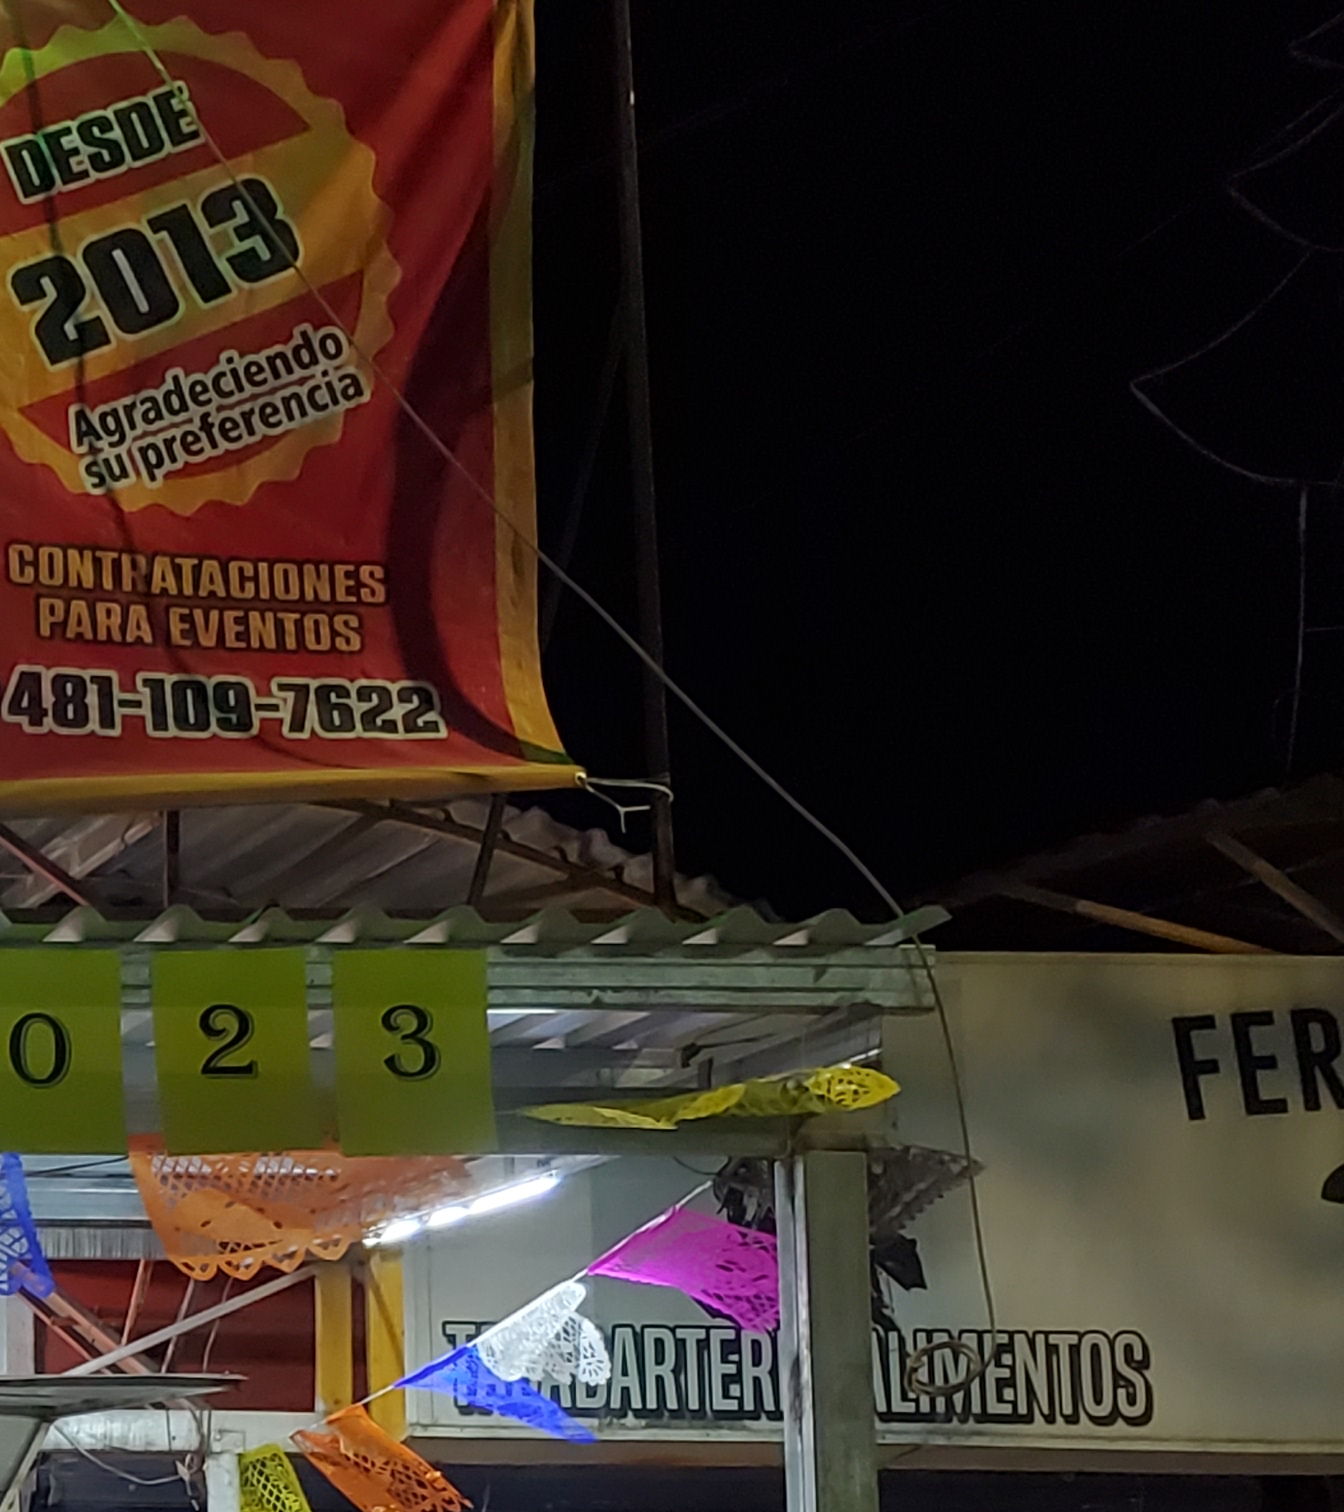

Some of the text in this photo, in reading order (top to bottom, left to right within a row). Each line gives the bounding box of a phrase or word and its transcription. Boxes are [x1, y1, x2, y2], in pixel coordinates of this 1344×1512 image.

[2, 83, 202, 201] DESDE
[10, 175, 301, 368] 2013
[72, 325, 344, 451] Agradeciendo
[83, 368, 365, 492] su preferencia
[8, 542, 387, 604] CONTRATACIONES
[38, 597, 363, 653] PARA EVENTOS
[6, 668, 446, 738] 481-109-7622
